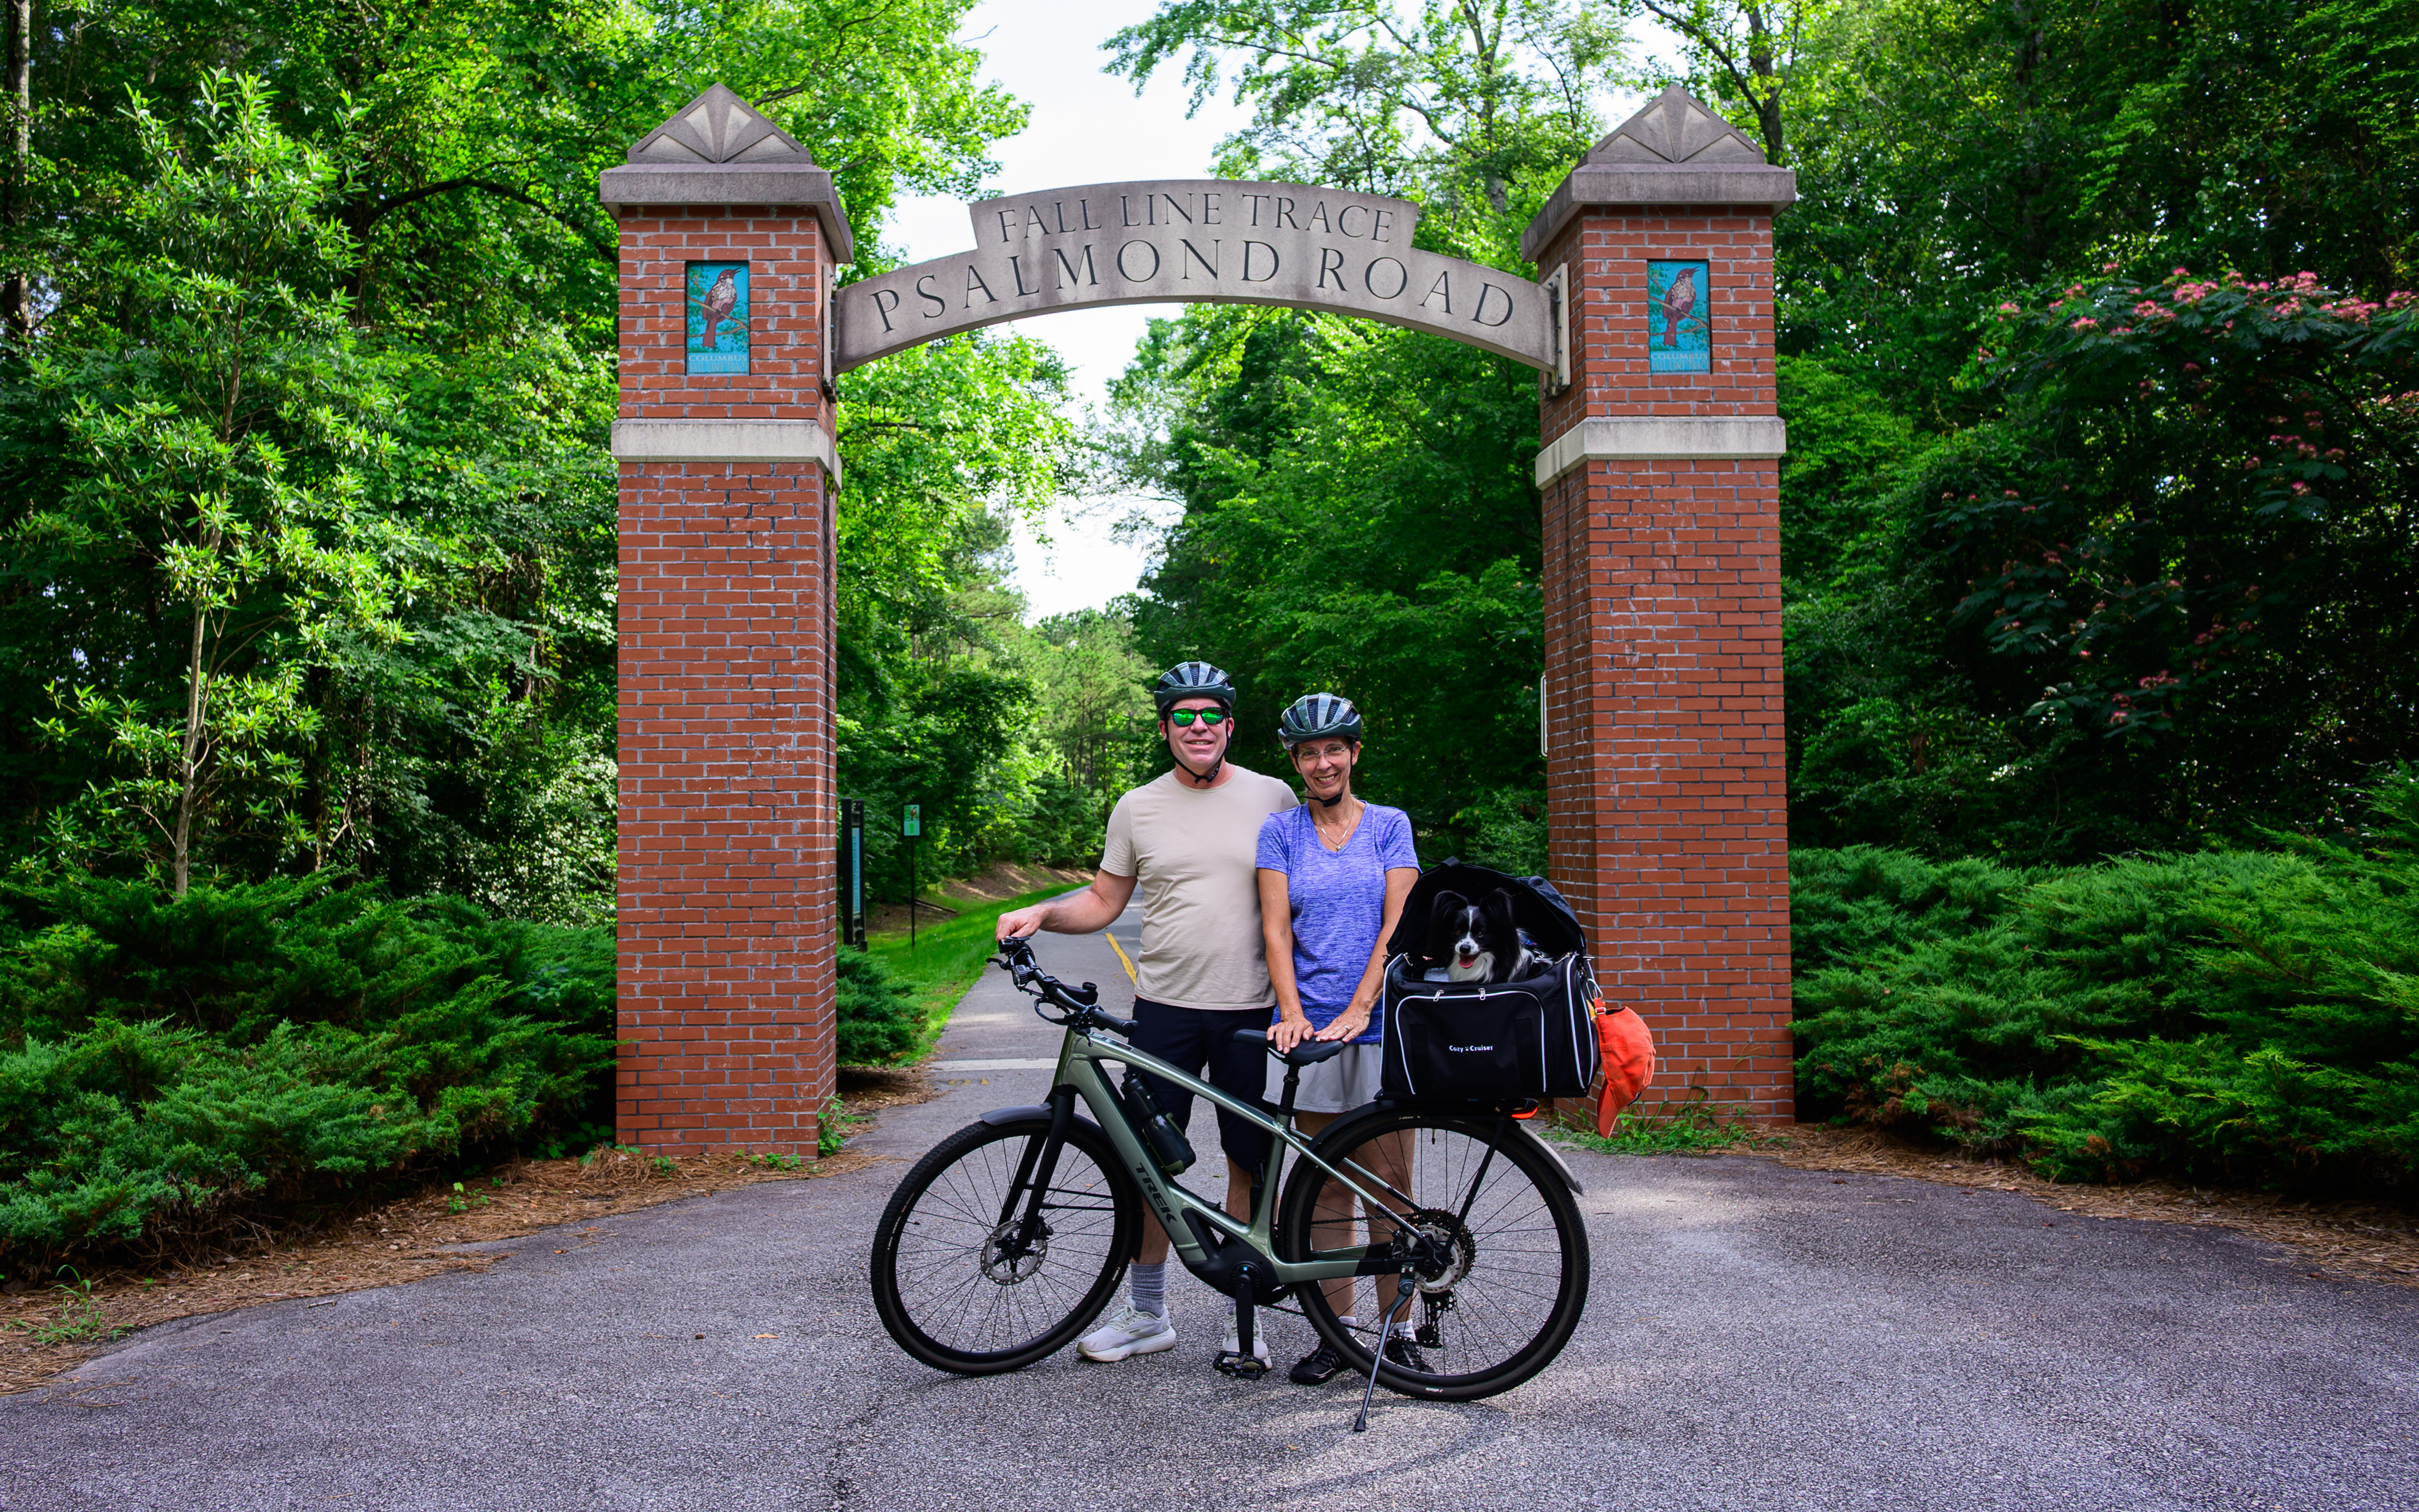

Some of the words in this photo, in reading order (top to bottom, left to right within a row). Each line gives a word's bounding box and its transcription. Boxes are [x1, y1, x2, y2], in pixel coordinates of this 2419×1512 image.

[997, 199, 1101, 242] FALL
[1120, 193, 1221, 226] LINE
[1242, 194, 1392, 242] TRACE
[869, 239, 1279, 333] PSALMOND
[1315, 247, 1513, 326] ROAD
[1136, 1162, 1178, 1224] TREK
